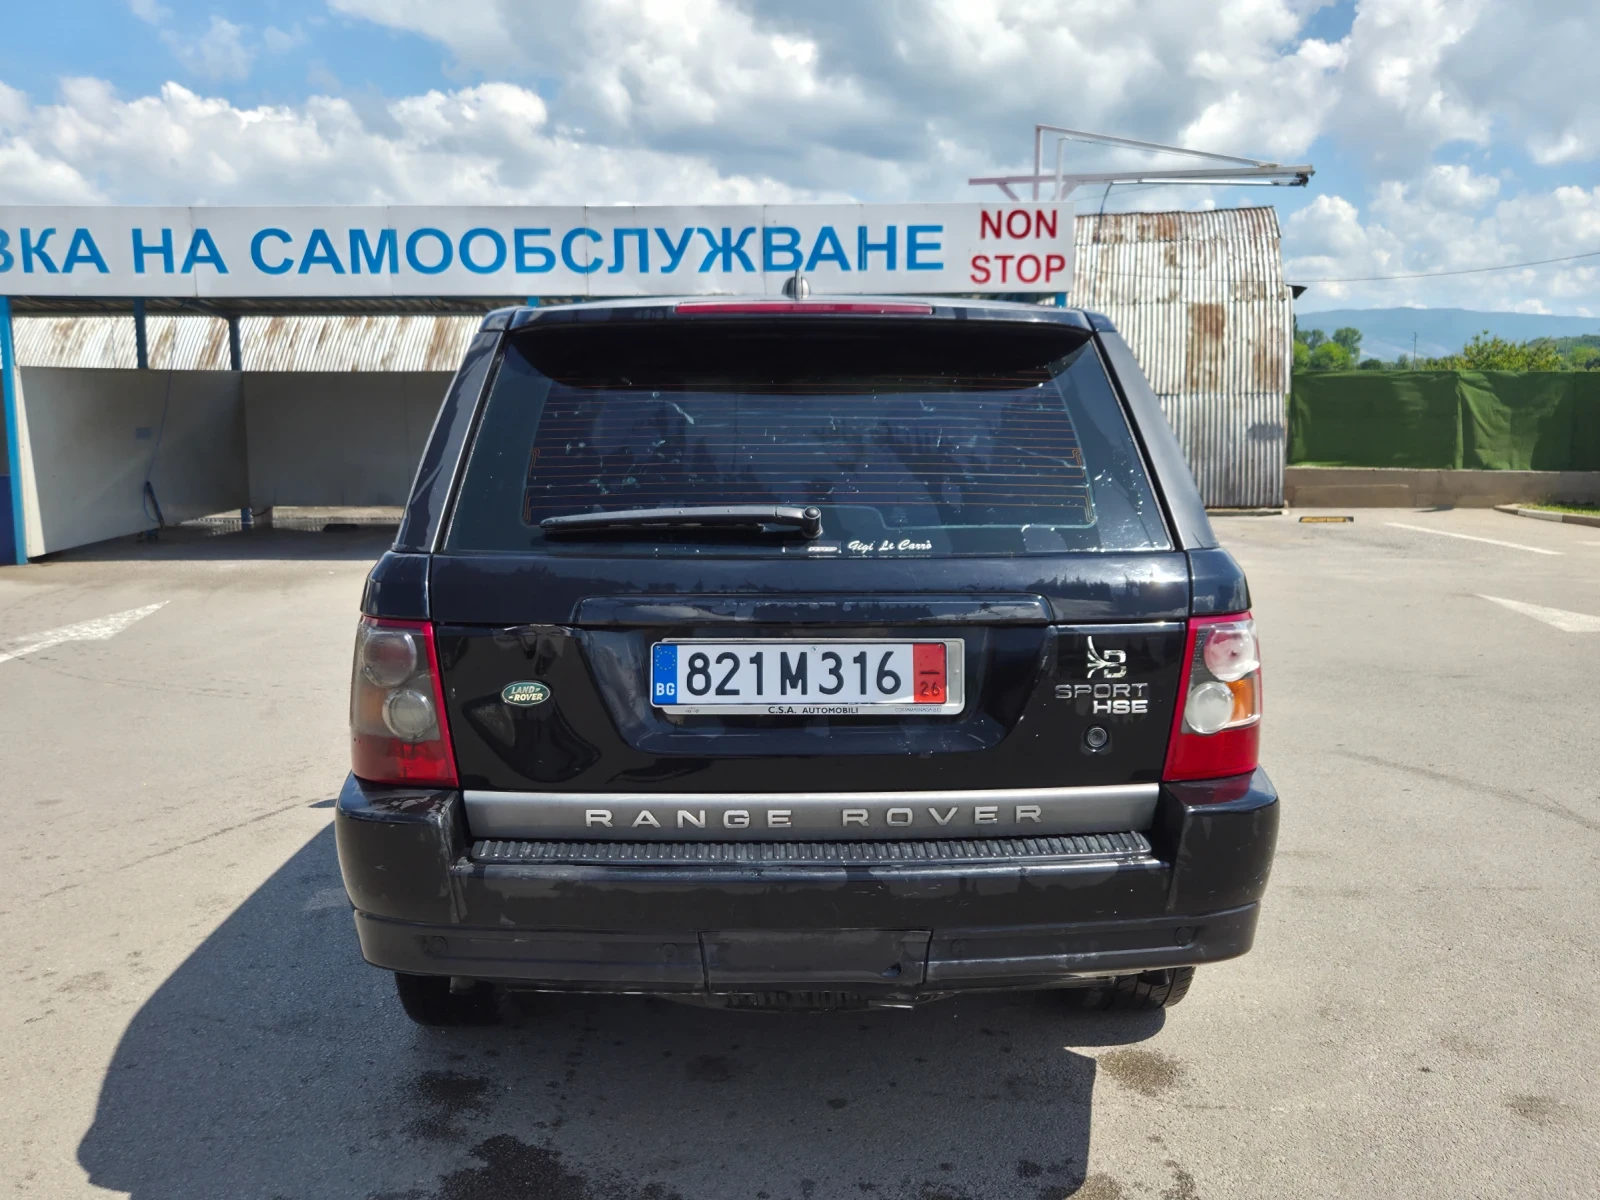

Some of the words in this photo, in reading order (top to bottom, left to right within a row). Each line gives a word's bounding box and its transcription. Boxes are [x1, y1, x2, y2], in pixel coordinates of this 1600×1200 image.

[979, 209, 1057, 240] NON
[133, 227, 229, 274] НА
[251, 225, 943, 274] САМООБСЛУЖВАНЕ
[970, 254, 1066, 284] STOP
[511, 686, 535, 694] LAND
[514, 693, 543, 701] ROVER
[656, 682, 675, 696] BG
[920, 681, 940, 697] 26
[1054, 682, 1149, 699] SPORT
[767, 706, 797, 714] C.S.A.
[1092, 699, 1149, 714] HSE
[584, 809, 793, 829] RANGE
[841, 804, 1044, 828] ROVER
